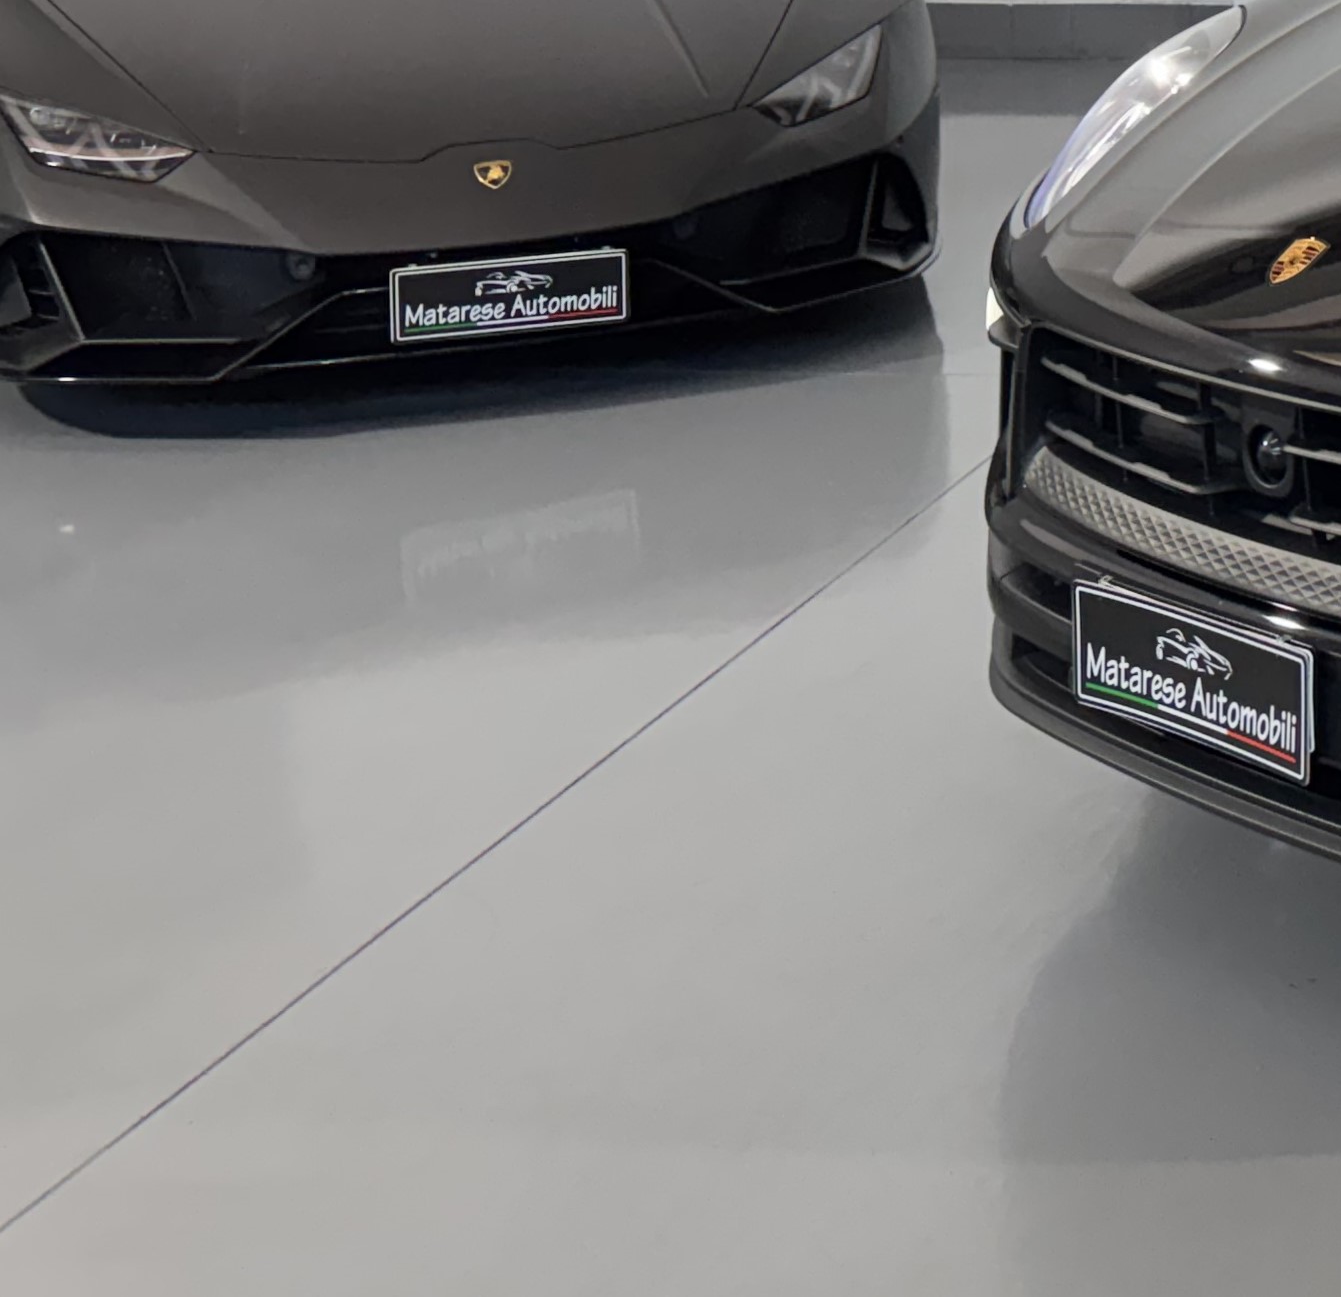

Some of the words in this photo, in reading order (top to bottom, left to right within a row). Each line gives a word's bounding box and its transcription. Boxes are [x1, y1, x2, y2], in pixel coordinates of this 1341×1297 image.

[404, 303, 506, 328] Matarese
[510, 285, 618, 318] Automobili
[1086, 642, 1187, 709] Matarese
[1190, 676, 1297, 754] Automobili
